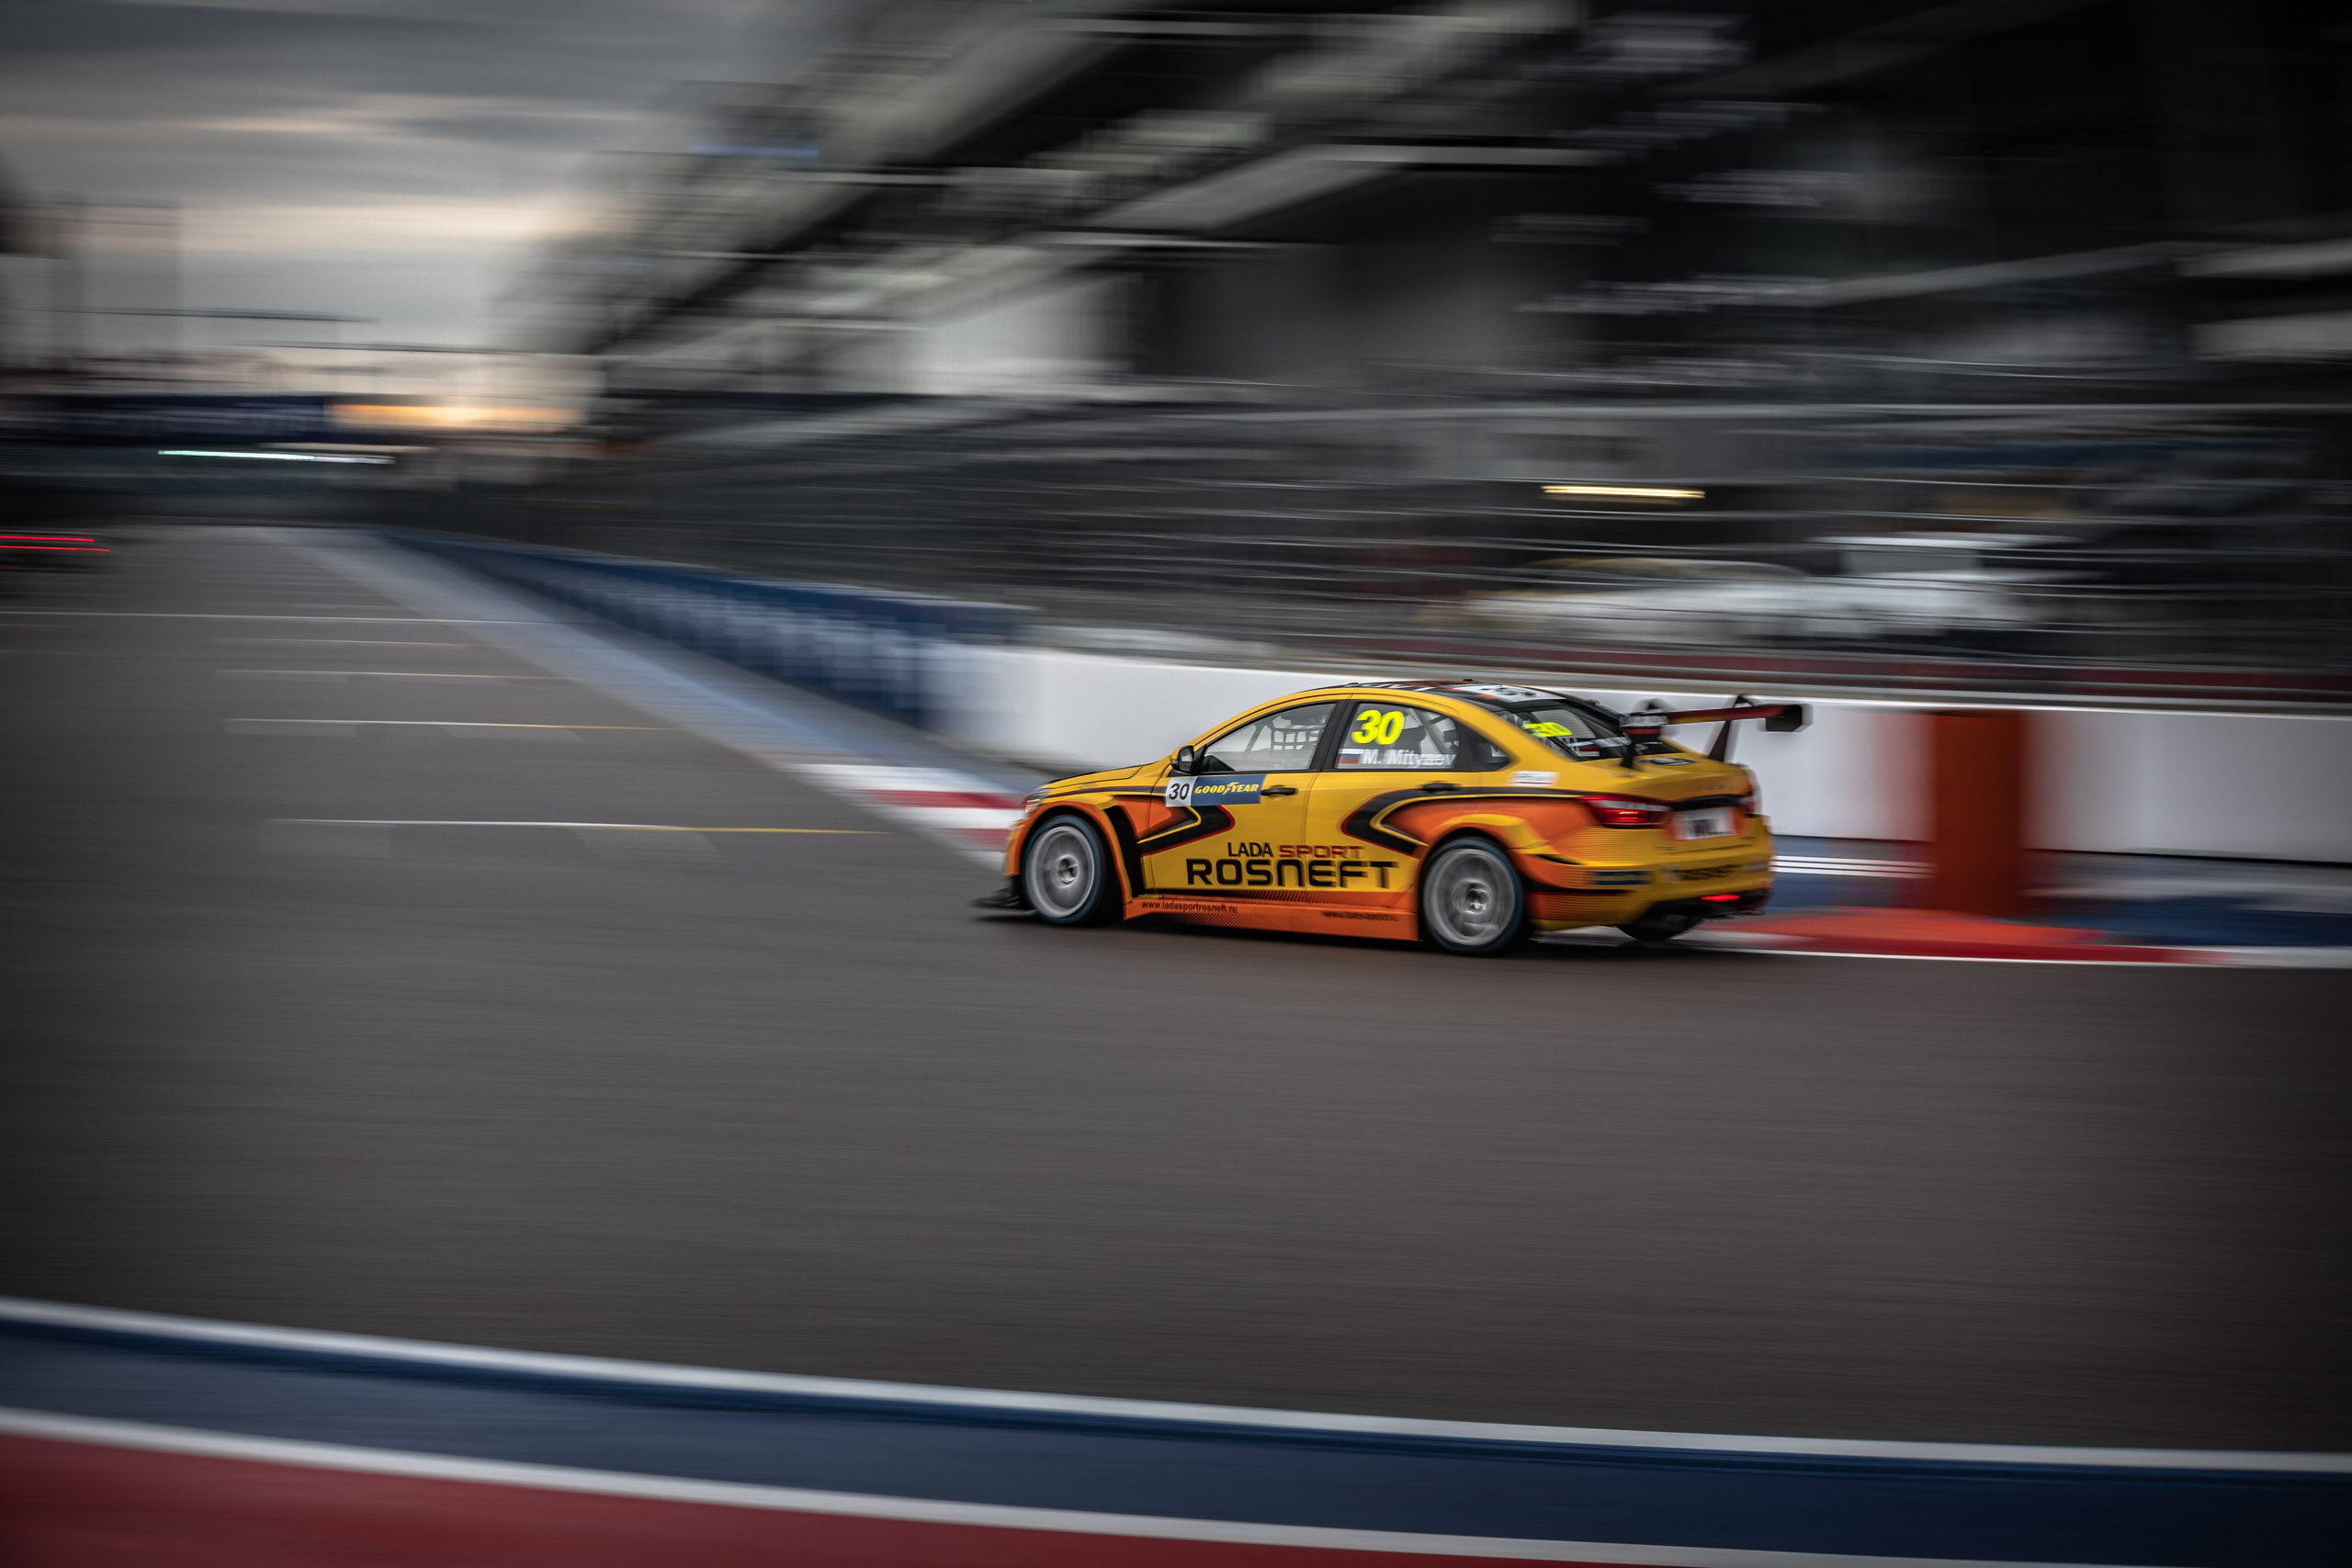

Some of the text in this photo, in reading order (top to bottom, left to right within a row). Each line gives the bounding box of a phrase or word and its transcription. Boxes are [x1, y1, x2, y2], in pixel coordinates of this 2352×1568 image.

[1351, 709, 1406, 745] 30
[1362, 749, 1382, 765] M.
[1168, 783, 1191, 801] 30
[1194, 782, 1260, 795] GOODYEAR
[1227, 841, 1365, 859] LADA SPORT
[1186, 858, 1399, 888] ROSNEFT
[1142, 900, 1238, 913] www.ladasportrosneft.ru
